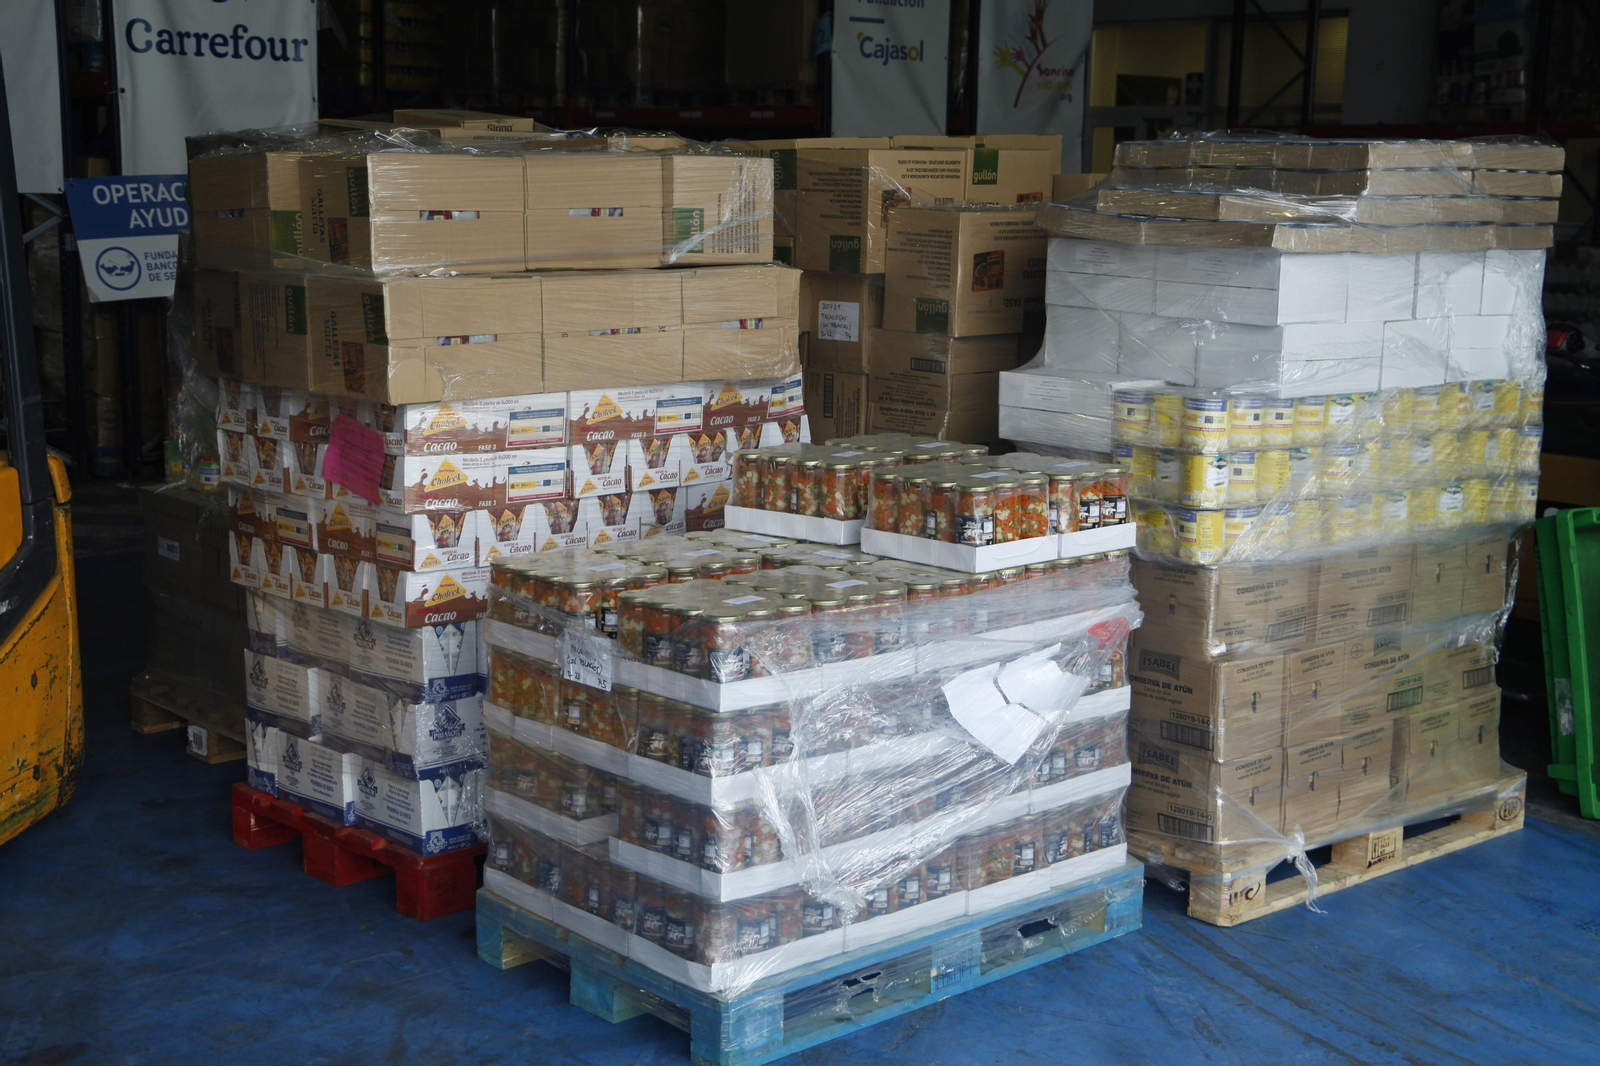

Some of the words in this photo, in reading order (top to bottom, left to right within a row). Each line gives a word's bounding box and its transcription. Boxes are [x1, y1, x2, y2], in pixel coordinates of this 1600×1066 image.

[125, 18, 308, 62] Carrefour
[859, 35, 924, 65] Cajasol
[973, 169, 997, 183] gullón
[92, 182, 187, 205] OPERAC
[348, 169, 358, 216] gullón
[317, 188, 326, 244] GALLETAS
[689, 210, 702, 251] gllón
[831, 237, 860, 252] gullón
[148, 273, 162, 281] DE
[917, 300, 948, 315] gullón
[1003, 298, 1022, 308] FASE:
[285, 287, 295, 333] gullón
[363, 295, 375, 344] gullón
[331, 311, 340, 367] GALLETAS
[591, 407, 619, 420] Choleck
[710, 414, 734, 426] Cacao
[586, 429, 614, 442] Cacao
[423, 441, 457, 453] Cacao
[659, 470, 678, 481] Cacao
[705, 465, 724, 476] Cacao
[308, 481, 325, 490] Cacao
[431, 472, 462, 487] Choleck
[602, 478, 622, 488] Cacao
[424, 498, 458, 508] Cacao
[617, 529, 637, 539] Cacao
[327, 538, 348, 551] Cacao
[565, 536, 586, 546] Cacao
[509, 544, 532, 554] Cacao
[447, 552, 470, 562] Cacao
[431, 587, 461, 602] Choleck
[1236, 585, 1265, 595] CONSERVA
[387, 609, 402, 619] Cacao
[424, 611, 457, 624] Cacao
[1142, 655, 1177, 673] ISABEL
[1364, 659, 1389, 670] CONSERVA
[1162, 682, 1172, 691] DE
[1173, 683, 1193, 695] ATÚN
[1299, 746, 1318, 756] CONSERVA
[1142, 749, 1176, 767] ISABEL
[1235, 761, 1257, 771] CONSERVA
[1160, 774, 1170, 783] DE
[1172, 776, 1193, 788] ATÚN
[1502, 800, 1519, 818] EUR
